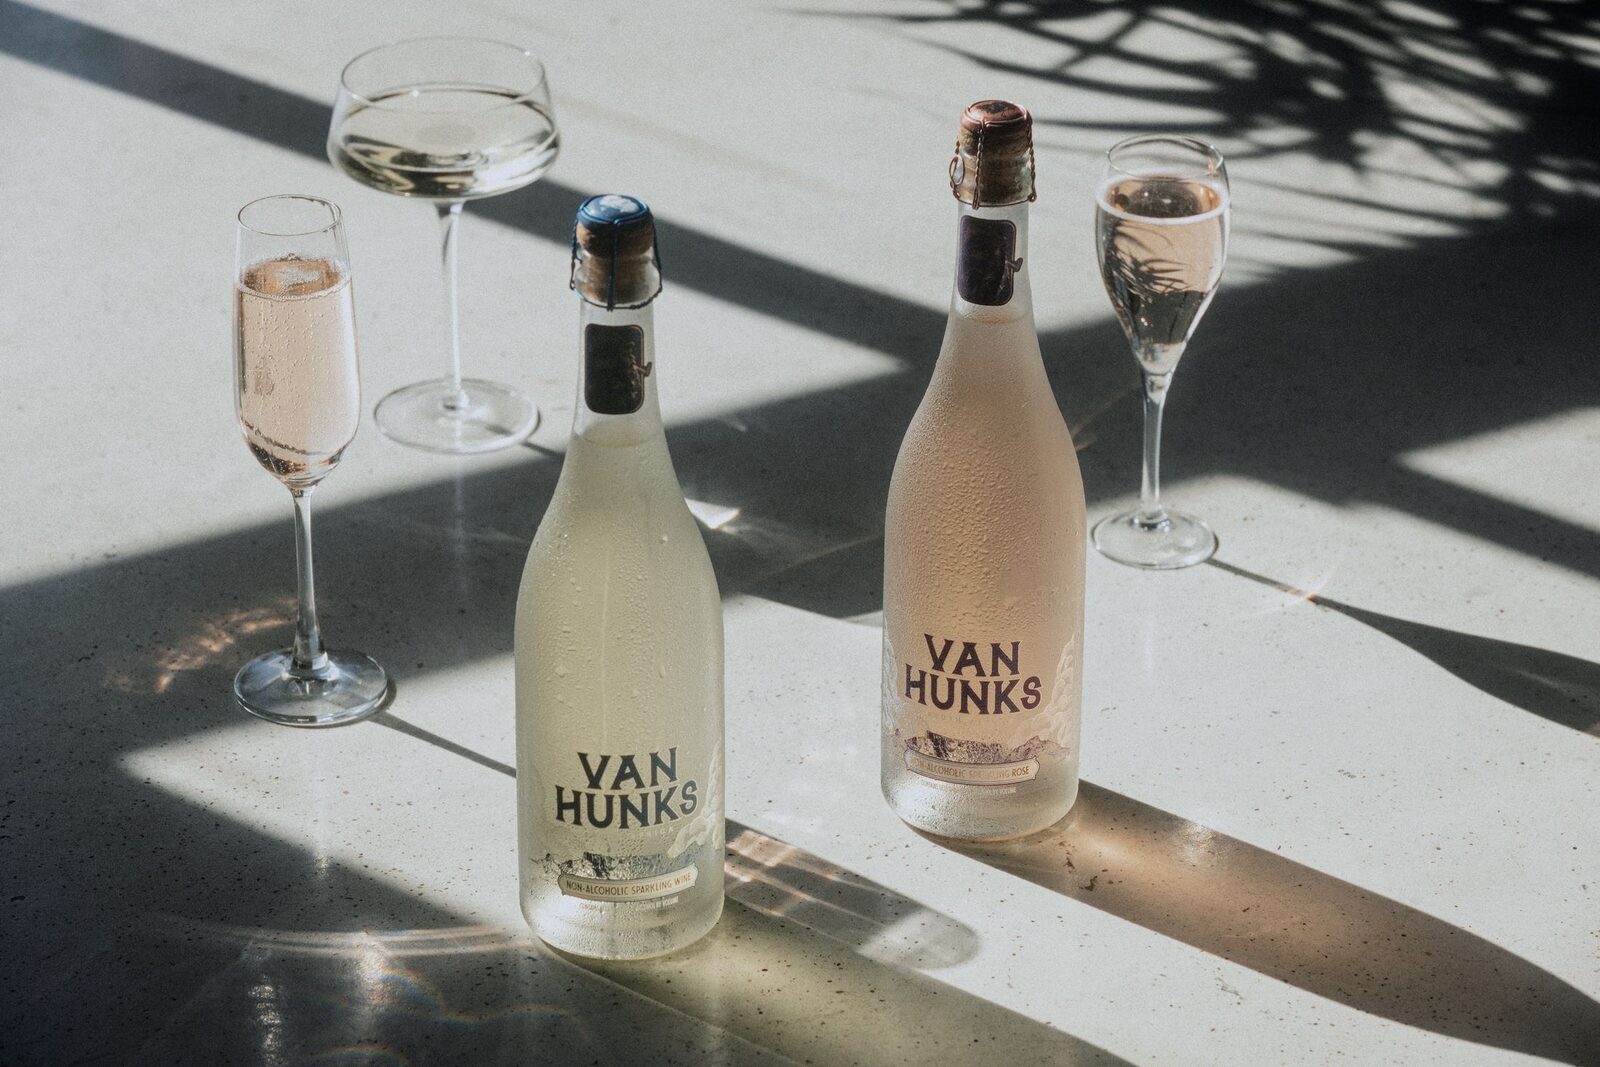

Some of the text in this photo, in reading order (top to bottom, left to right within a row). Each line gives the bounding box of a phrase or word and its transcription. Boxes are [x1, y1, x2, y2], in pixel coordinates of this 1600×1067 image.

[924, 634, 1020, 677] VAN
[905, 664, 1042, 714] HUNKS
[577, 747, 678, 790] VAN
[555, 780, 698, 829] HUNKS
[566, 872, 692, 896] NON-ALCOHOLIC SPARKLING WINE
